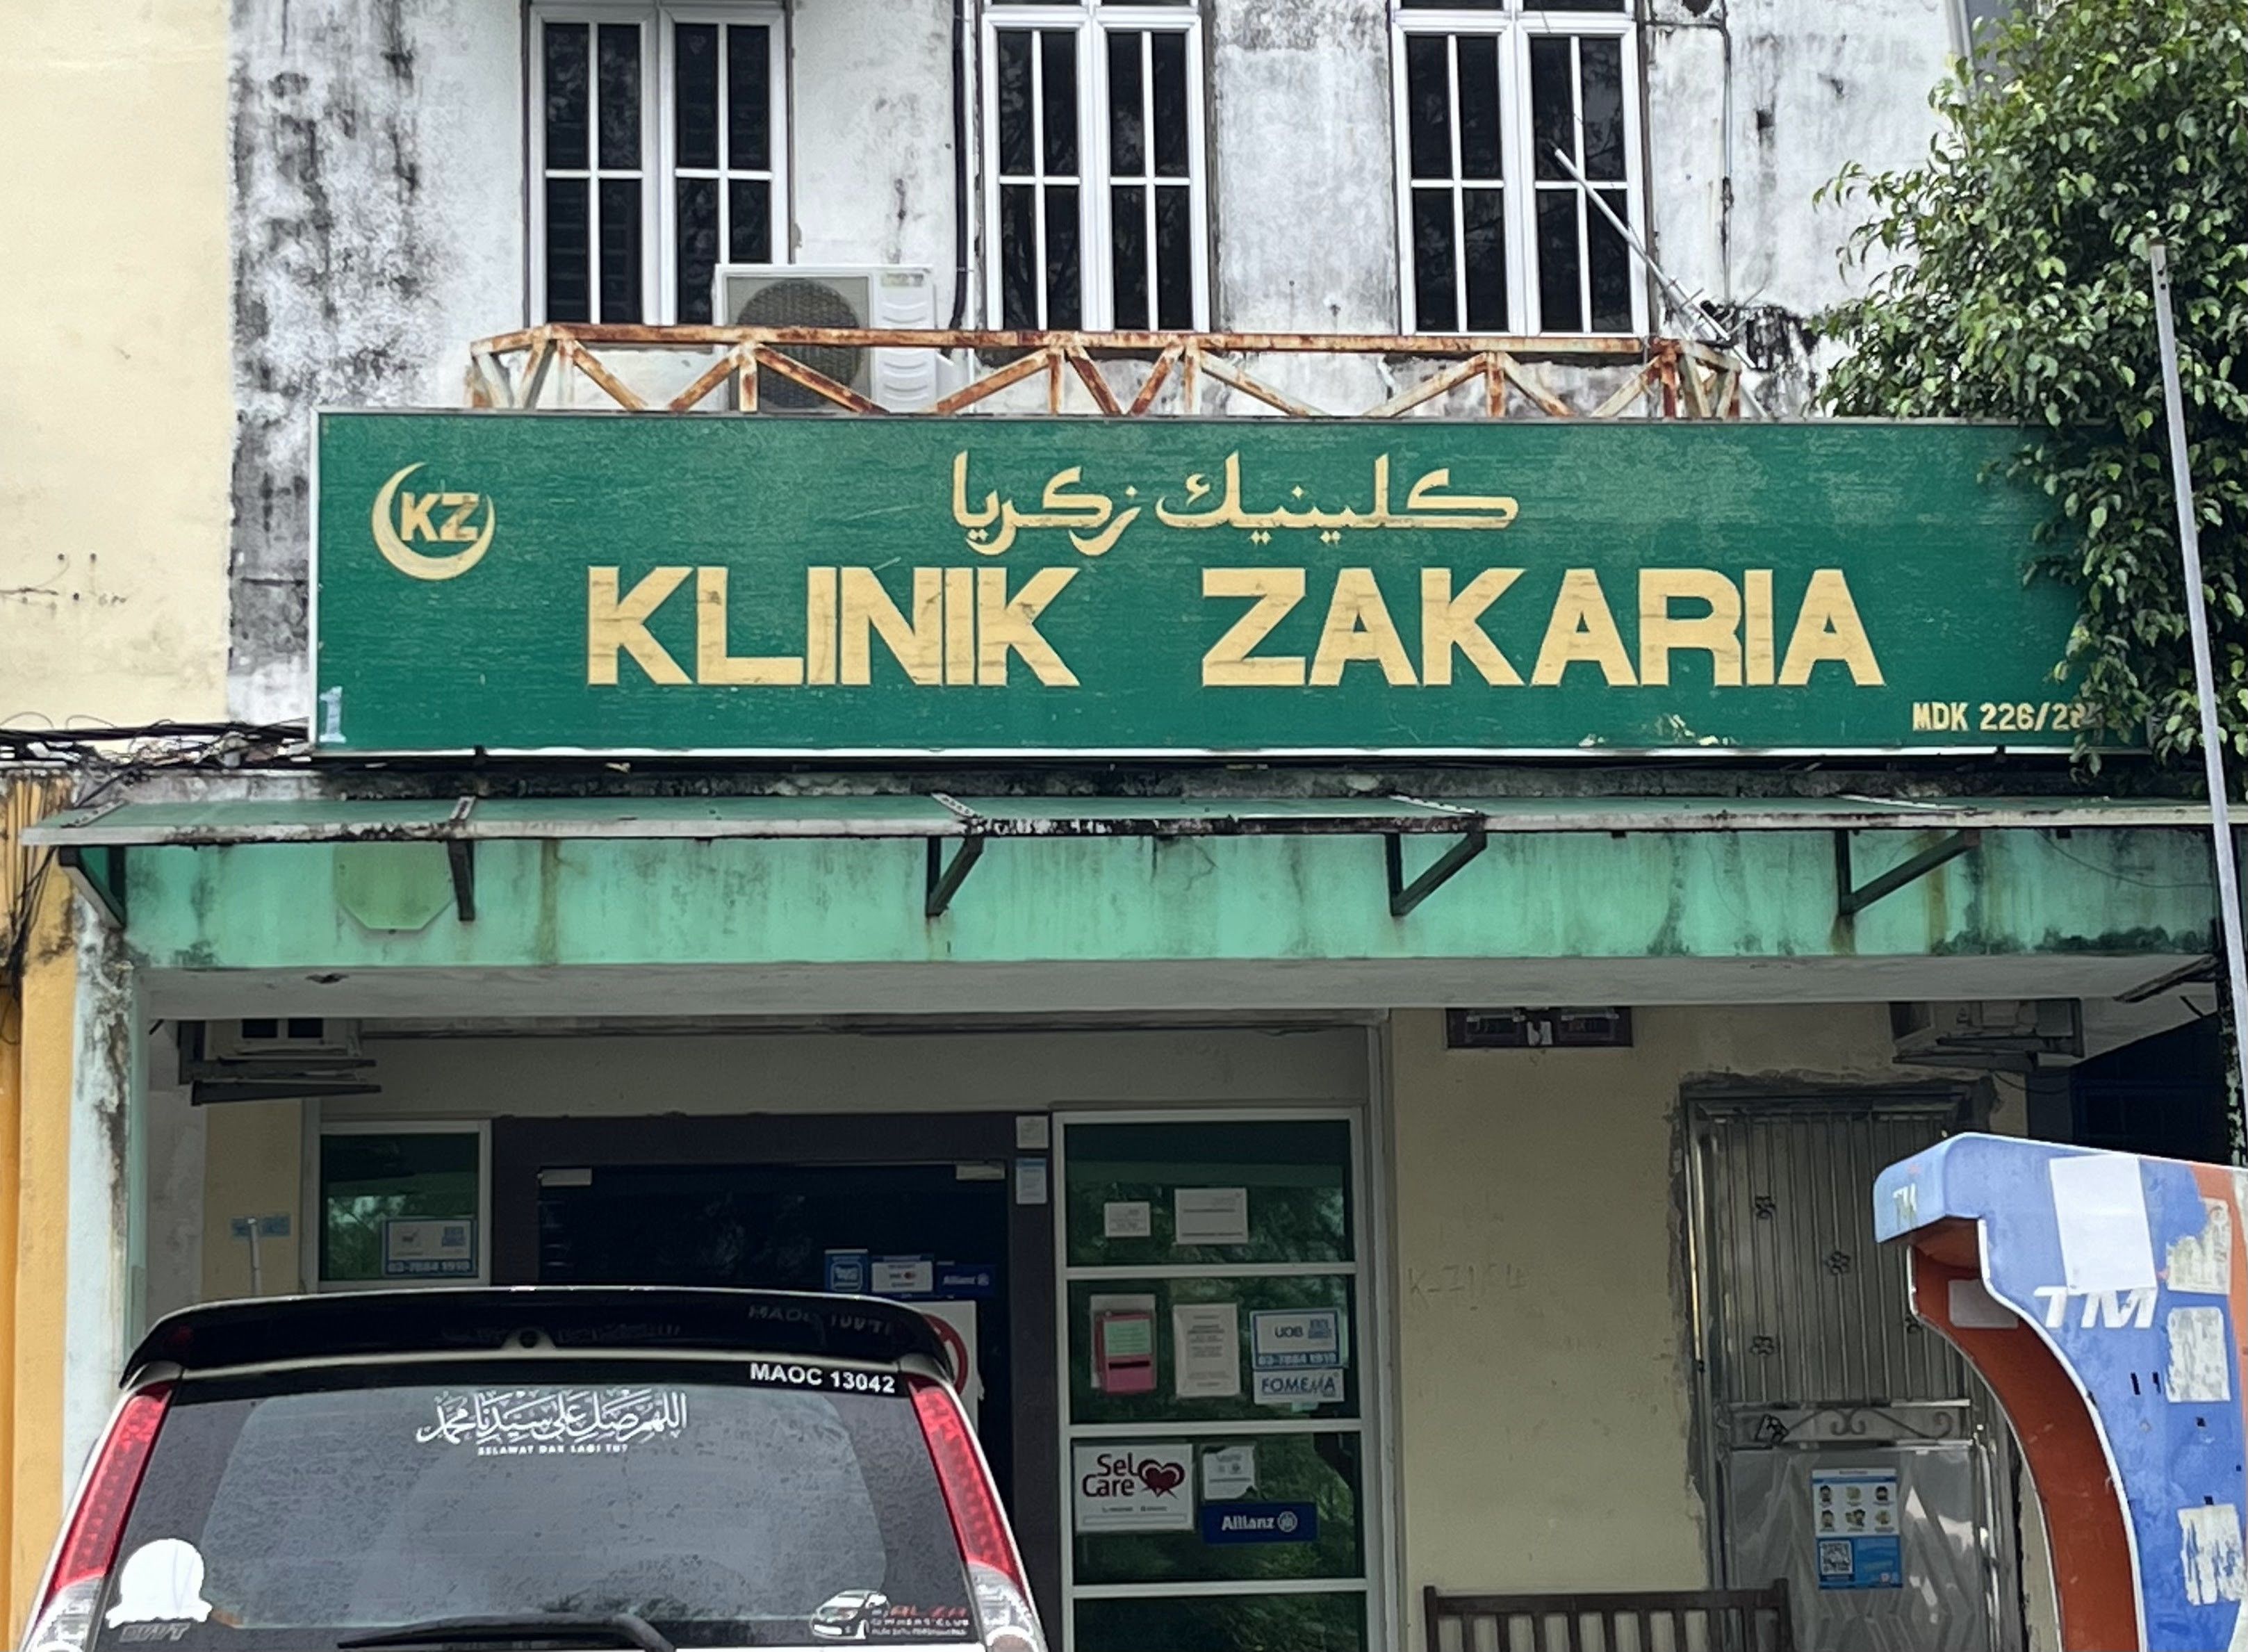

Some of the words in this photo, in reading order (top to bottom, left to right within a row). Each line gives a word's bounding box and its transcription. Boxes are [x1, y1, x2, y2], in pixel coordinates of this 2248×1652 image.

[400, 492, 479, 542] KZ
[953, 450, 1142, 556] زكريا
[586, 566, 1081, 686] KLINIK
[1201, 567, 1885, 687] ZAKARIA
[1912, 702, 1969, 732] MDK
[2033, 1285, 2158, 1329] TM
[749, 1362, 823, 1386] MAOC
[830, 1371, 895, 1393] 13042
[477, 1445, 534, 1456] SELAWAT
[1097, 1452, 1138, 1478] Sel
[1082, 1473, 1135, 1498] Care
[1221, 1514, 1275, 1531] Allianz
